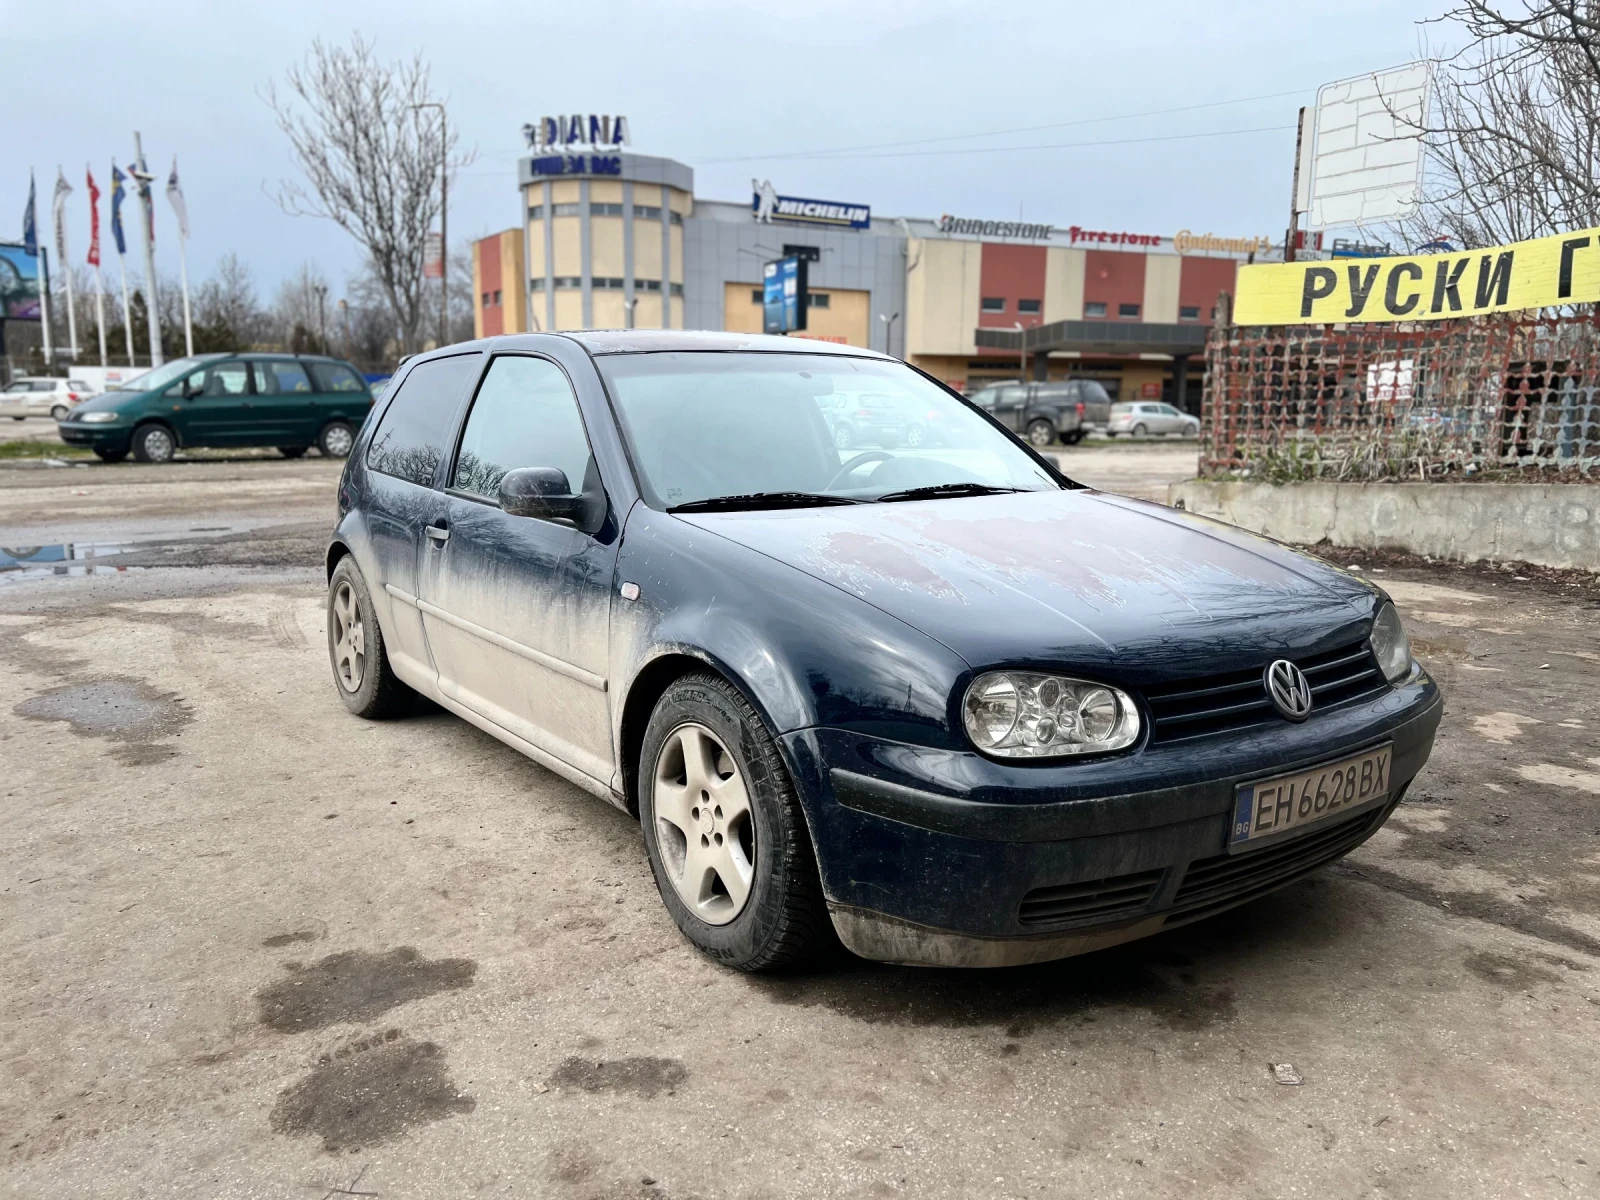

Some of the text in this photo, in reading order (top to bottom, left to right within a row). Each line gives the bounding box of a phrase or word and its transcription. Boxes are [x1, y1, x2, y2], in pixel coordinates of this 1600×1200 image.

[541, 114, 631, 146] DIANA
[778, 200, 868, 222] MICHELIN
[940, 214, 1055, 241] BRIDGESTONE
[1069, 226, 1161, 247] Firestone
[1300, 234, 1600, 318] РУСКИ Г
[1236, 822, 1249, 835] BG
